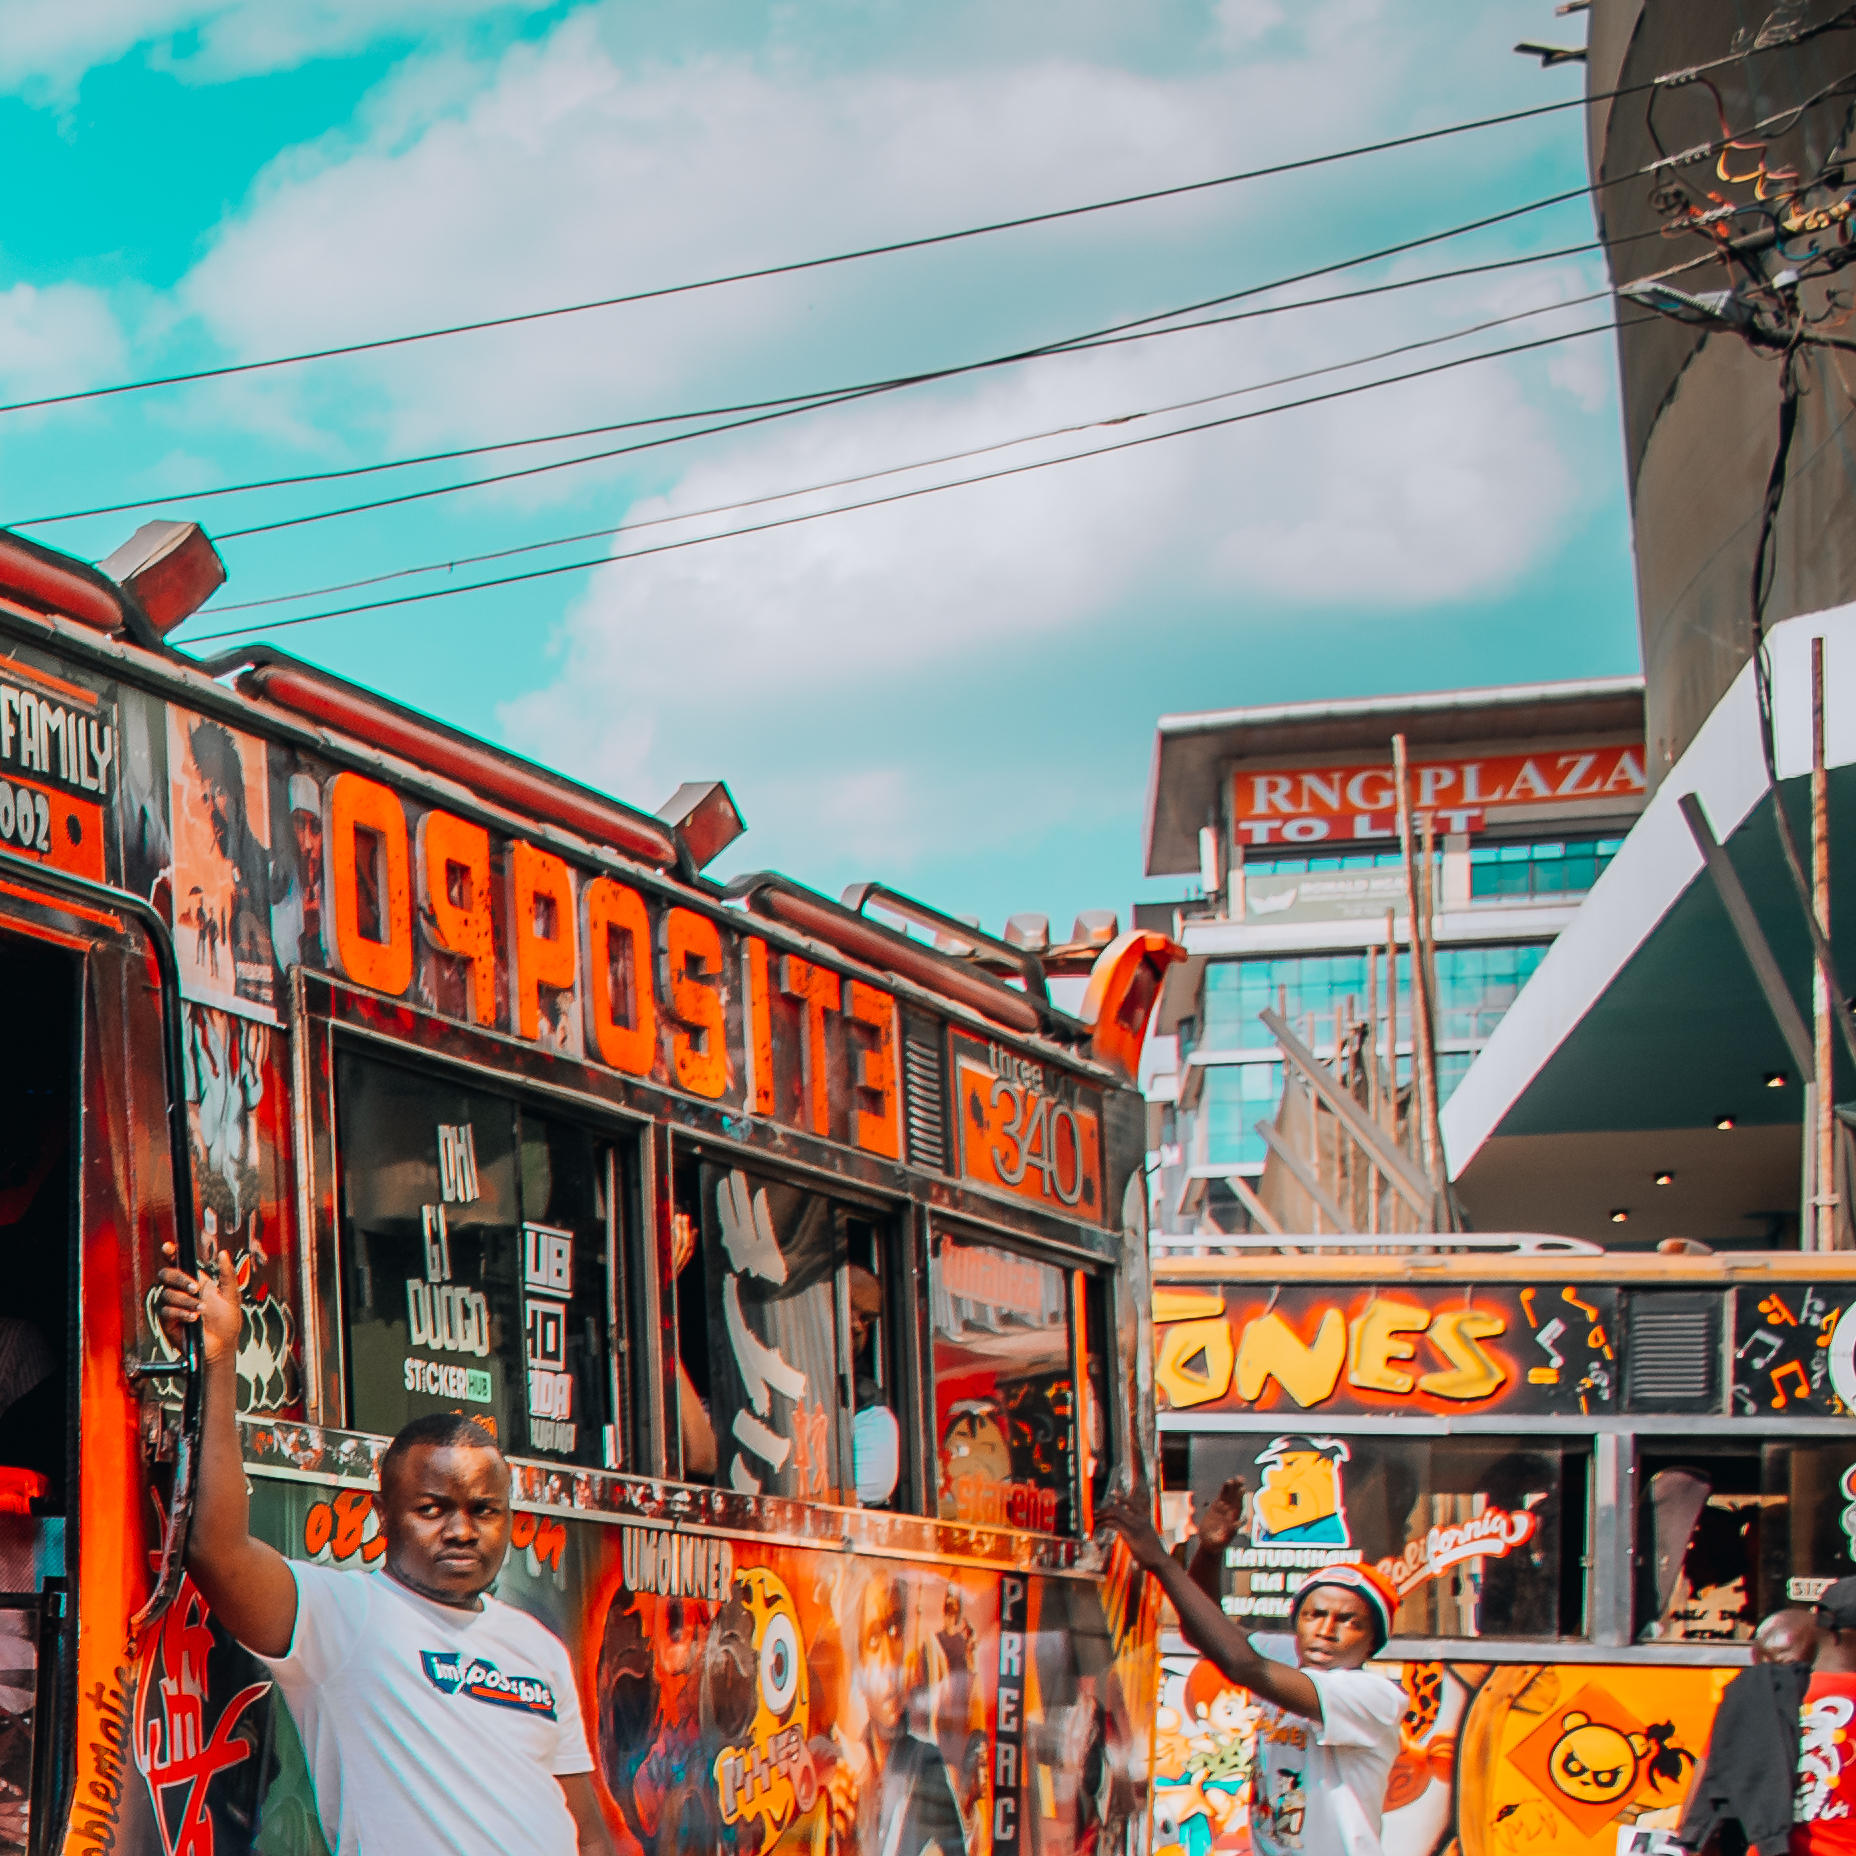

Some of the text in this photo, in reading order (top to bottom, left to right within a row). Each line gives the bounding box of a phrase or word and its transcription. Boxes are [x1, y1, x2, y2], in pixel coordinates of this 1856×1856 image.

[0, 684, 115, 794] FAMILY
[1251, 750, 1648, 815] RNG PLAZA
[1239, 816, 1331, 844] TO
[990, 1078, 1082, 1206] 340
